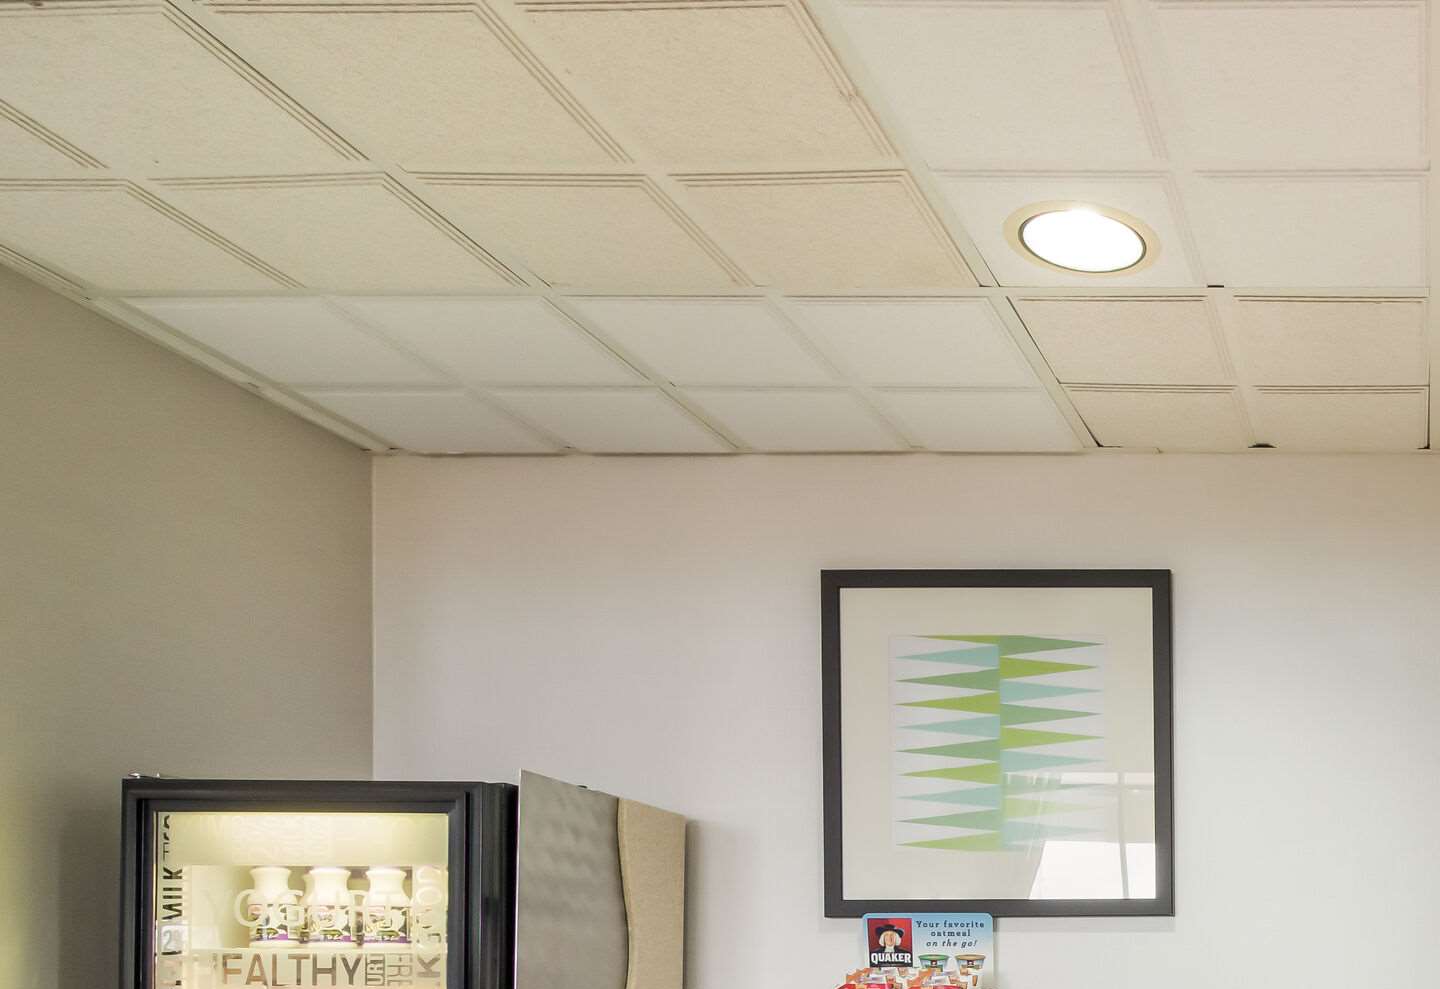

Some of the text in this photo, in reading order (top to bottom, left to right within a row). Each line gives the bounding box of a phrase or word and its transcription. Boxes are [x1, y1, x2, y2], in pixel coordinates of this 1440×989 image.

[916, 920, 985, 929] Your favorite
[930, 929, 971, 938] oatmeal
[926, 939, 978, 949] on the go!
[870, 952, 912, 964] QUAKER
